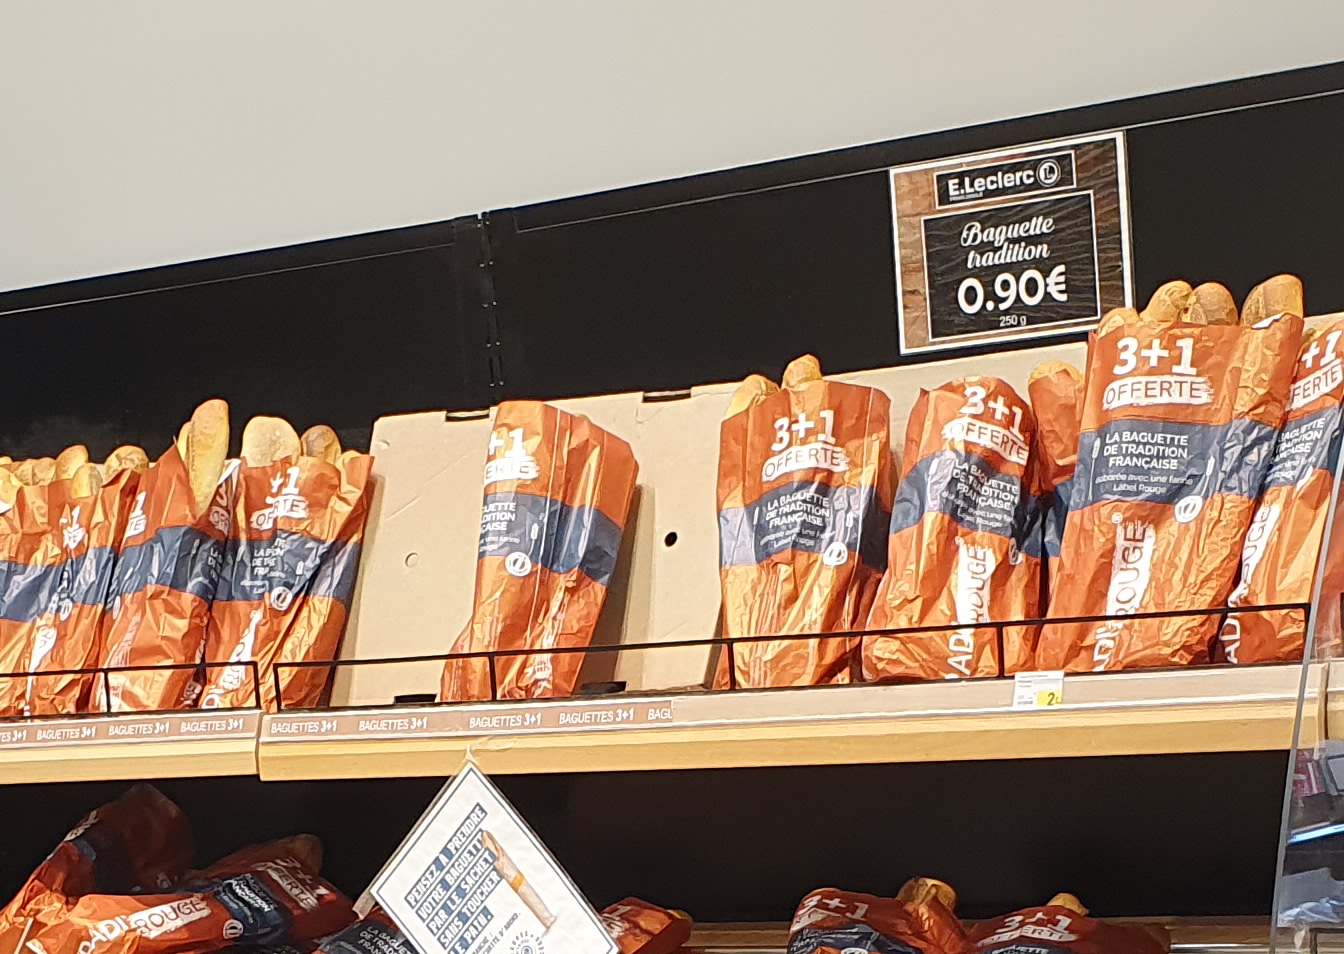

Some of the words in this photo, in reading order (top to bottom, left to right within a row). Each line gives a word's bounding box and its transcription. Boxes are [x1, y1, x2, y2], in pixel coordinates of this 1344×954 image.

[948, 168, 1035, 197] E.Leclerc
[960, 215, 1055, 247] Baguette
[966, 241, 1051, 269] tradition
[957, 264, 1068, 314] 0.90€
[999, 316, 1019, 327] 250
[1113, 336, 1198, 375] 3+1
[1106, 380, 1204, 405] OFFERTE
[1292, 364, 1342, 401] FERTE
[959, 385, 1025, 441] 3+1
[771, 410, 836, 452] 3+1
[949, 422, 1029, 460] OFFERTE
[1105, 432, 1120, 443] LA
[1122, 431, 1189, 446] BAGUETTE
[764, 447, 841, 478] OFFERTE
[1103, 444, 1118, 456] DE
[1120, 443, 1188, 459] TRADITION
[1108, 456, 1179, 470] FRANÇAISE
[952, 468, 966, 481] DE
[968, 475, 1019, 504] TRADITION
[955, 459, 969, 471] LA
[970, 464, 1019, 494] BAGUETTE
[766, 510, 777, 521] DE
[779, 502, 830, 518] TRADITION
[767, 500, 779, 511] LA
[780, 493, 829, 507] BAGUETTE
[956, 482, 1012, 511] FRANÇAISE
[769, 511, 824, 529] FRANÇAISE
[320, 720, 337, 732] 3+1
[410, 717, 428, 729] 3+1
[469, 715, 522, 728] BAGUETTES
[524, 713, 542, 725] 3+1
[559, 711, 614, 724] BAGUETTES
[615, 708, 635, 721] 3+1
[406, 864, 441, 907] PENSEZ
[447, 805, 487, 856] PRENDRE
[417, 884, 447, 920] VOTRE
[444, 830, 484, 884] BAGUETT
[428, 909, 449, 934] PAR
[448, 890, 463, 909] LE
[460, 851, 495, 893] SACHET
[137, 897, 207, 937] ROUGE
[439, 916, 464, 948] SANS
[462, 871, 501, 916] TOUCHER
